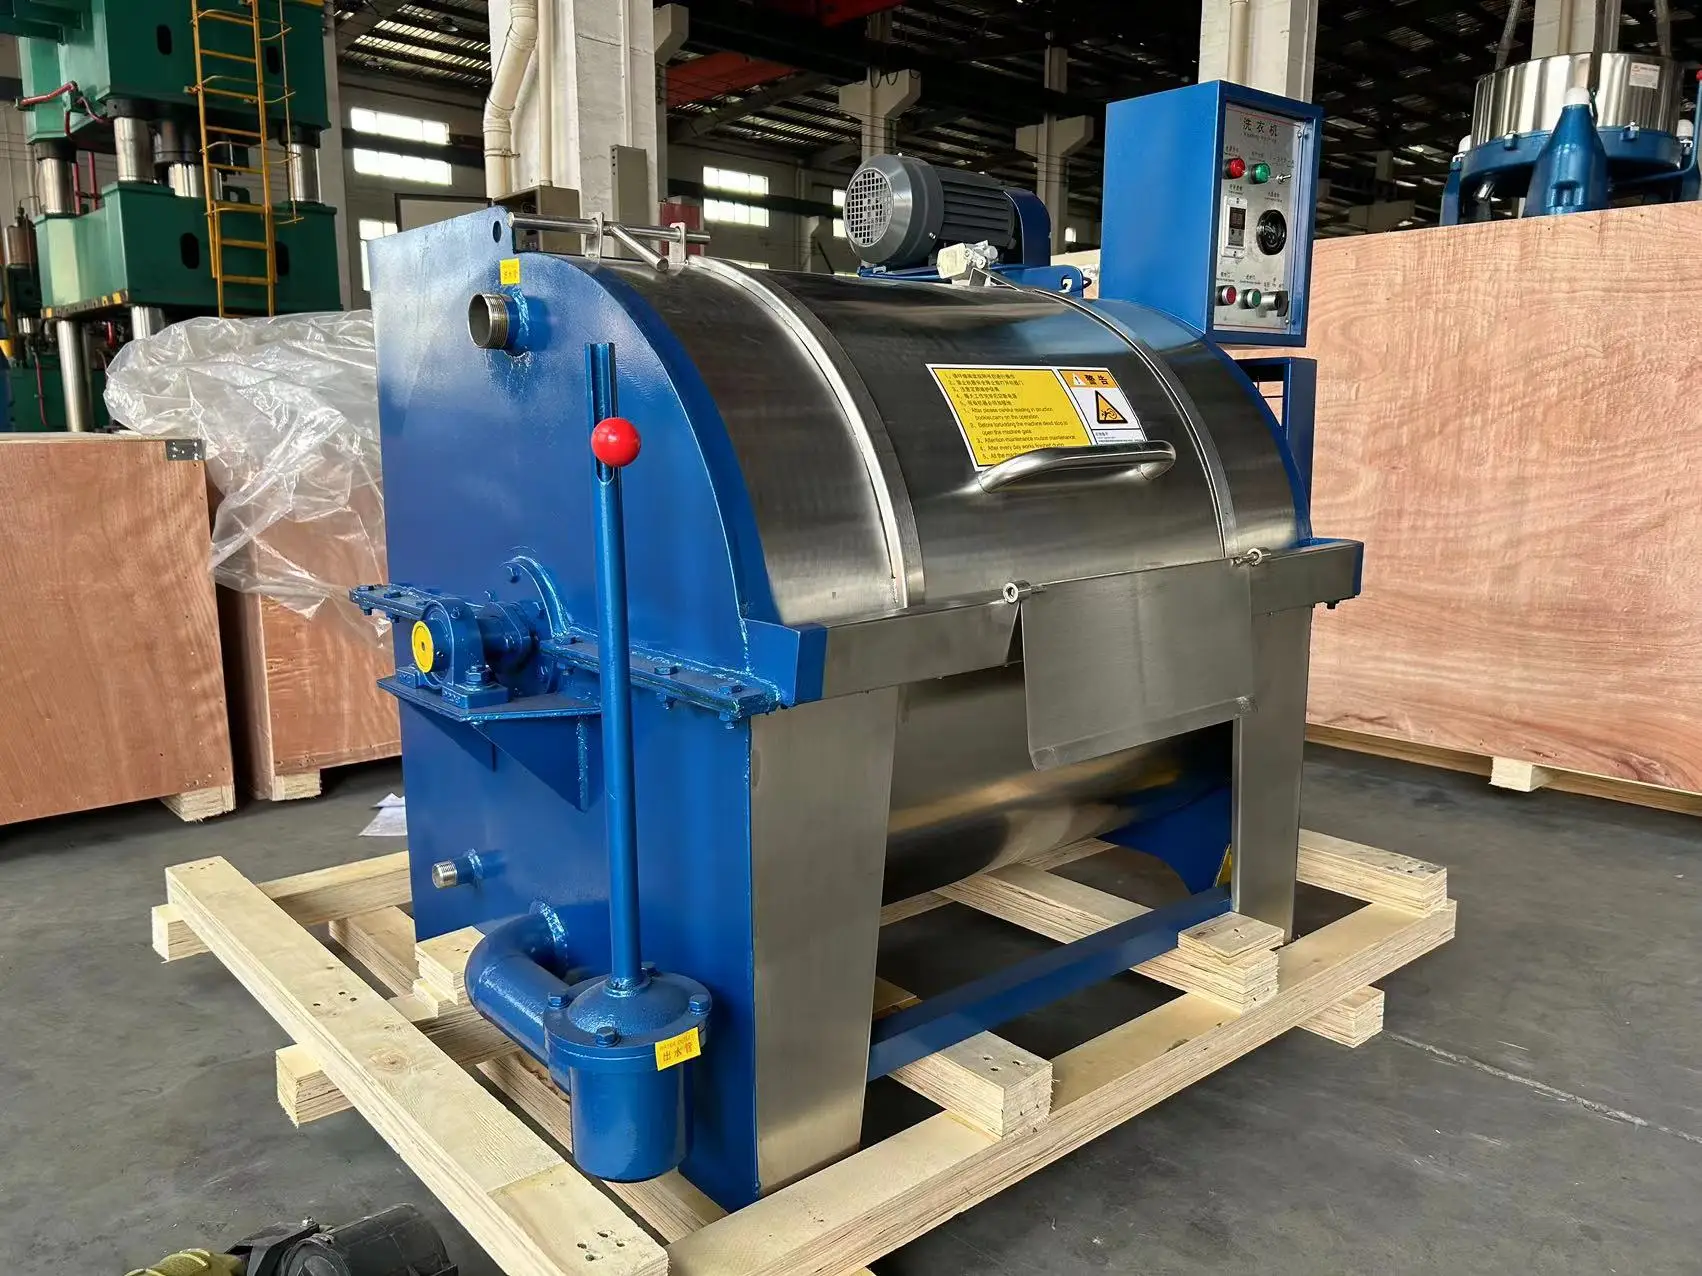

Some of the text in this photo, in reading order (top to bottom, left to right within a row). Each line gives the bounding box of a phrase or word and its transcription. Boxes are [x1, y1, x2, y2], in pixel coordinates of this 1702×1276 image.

[1243, 118, 1278, 137] 洗衣机
[1085, 374, 1109, 385] 警告
[663, 1041, 693, 1061] 出水管
